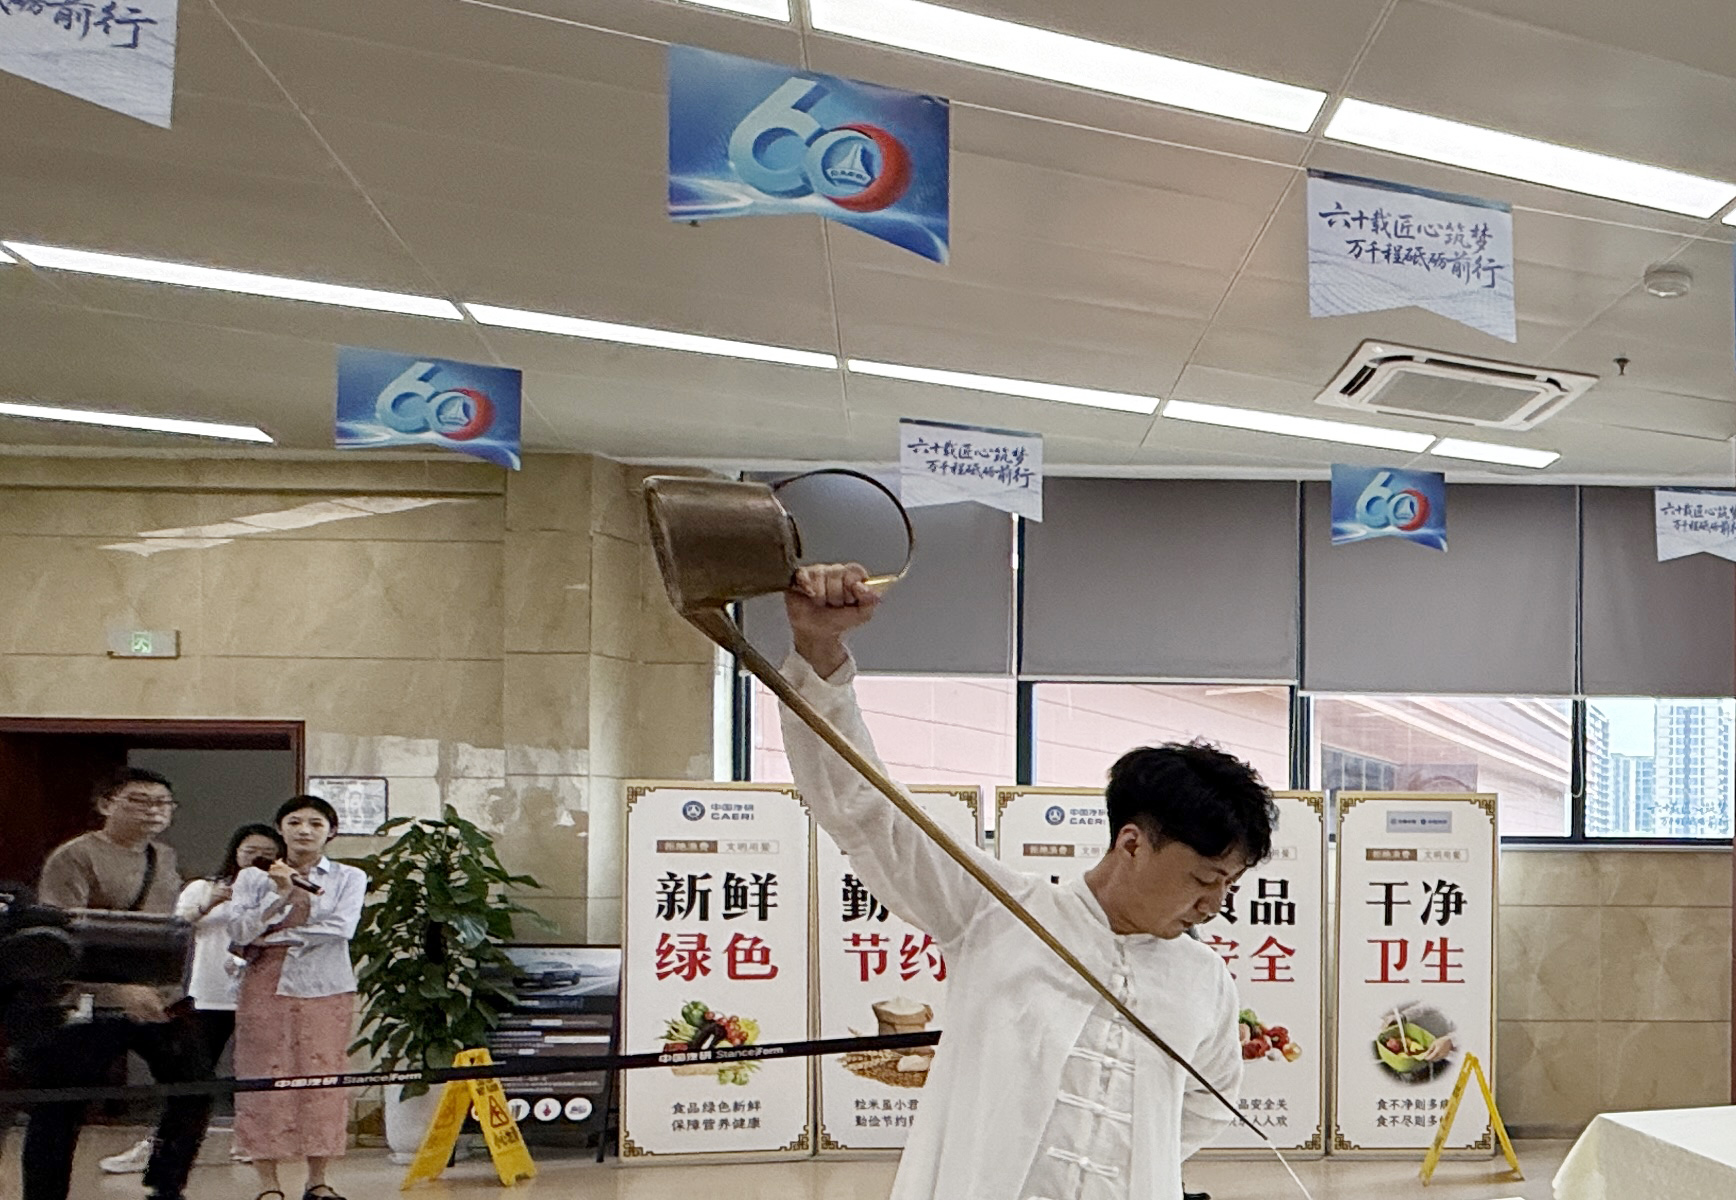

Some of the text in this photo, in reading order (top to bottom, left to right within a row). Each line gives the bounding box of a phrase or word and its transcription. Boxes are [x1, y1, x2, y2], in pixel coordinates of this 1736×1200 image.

[0, 0, 158, 49] 前行
[728, 76, 912, 213] 60
[1318, 201, 1494, 255] 六十载匠心筑梦
[375, 361, 497, 441] 60
[1355, 471, 1432, 532] 60
[710, 812, 755, 821] CAERI
[655, 871, 779, 921] 新鲜
[1365, 878, 1469, 927] 干净
[655, 932, 779, 981] 绿色
[842, 933, 948, 982] 节约
[1364, 937, 1466, 983] 卫生
[672, 1100, 761, 1114] 食品绿色新鲜
[672, 1117, 761, 1131] 保障营养健康
[1376, 1115, 1444, 1127] 食不尽则多
